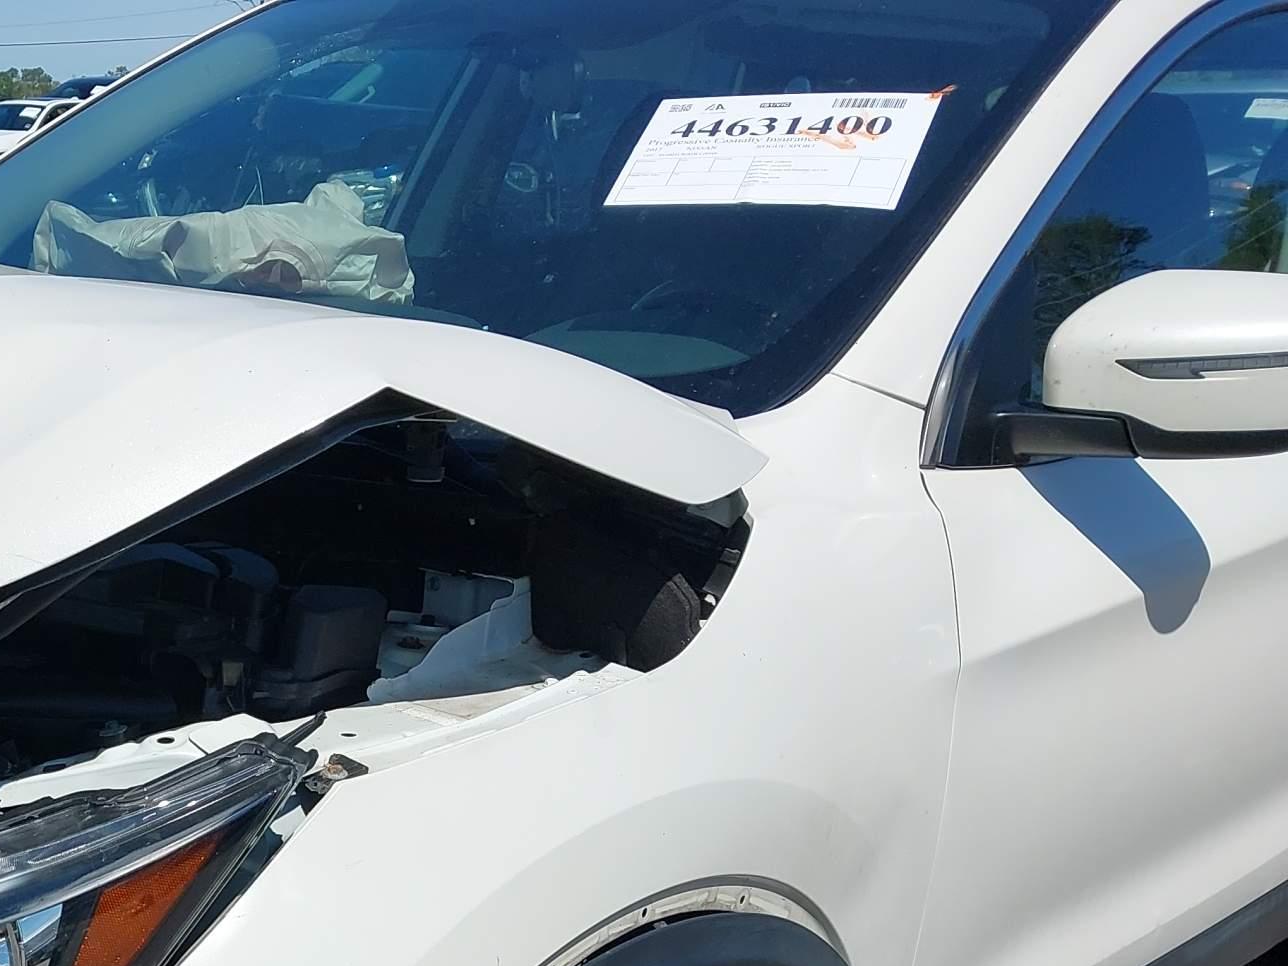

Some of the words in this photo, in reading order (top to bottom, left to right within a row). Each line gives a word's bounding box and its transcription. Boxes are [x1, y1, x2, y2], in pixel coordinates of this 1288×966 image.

[670, 115, 894, 138] 44631400
[647, 138, 712, 147] Progressive
[713, 136, 761, 145] Casualty
[766, 135, 821, 143] Insurance
